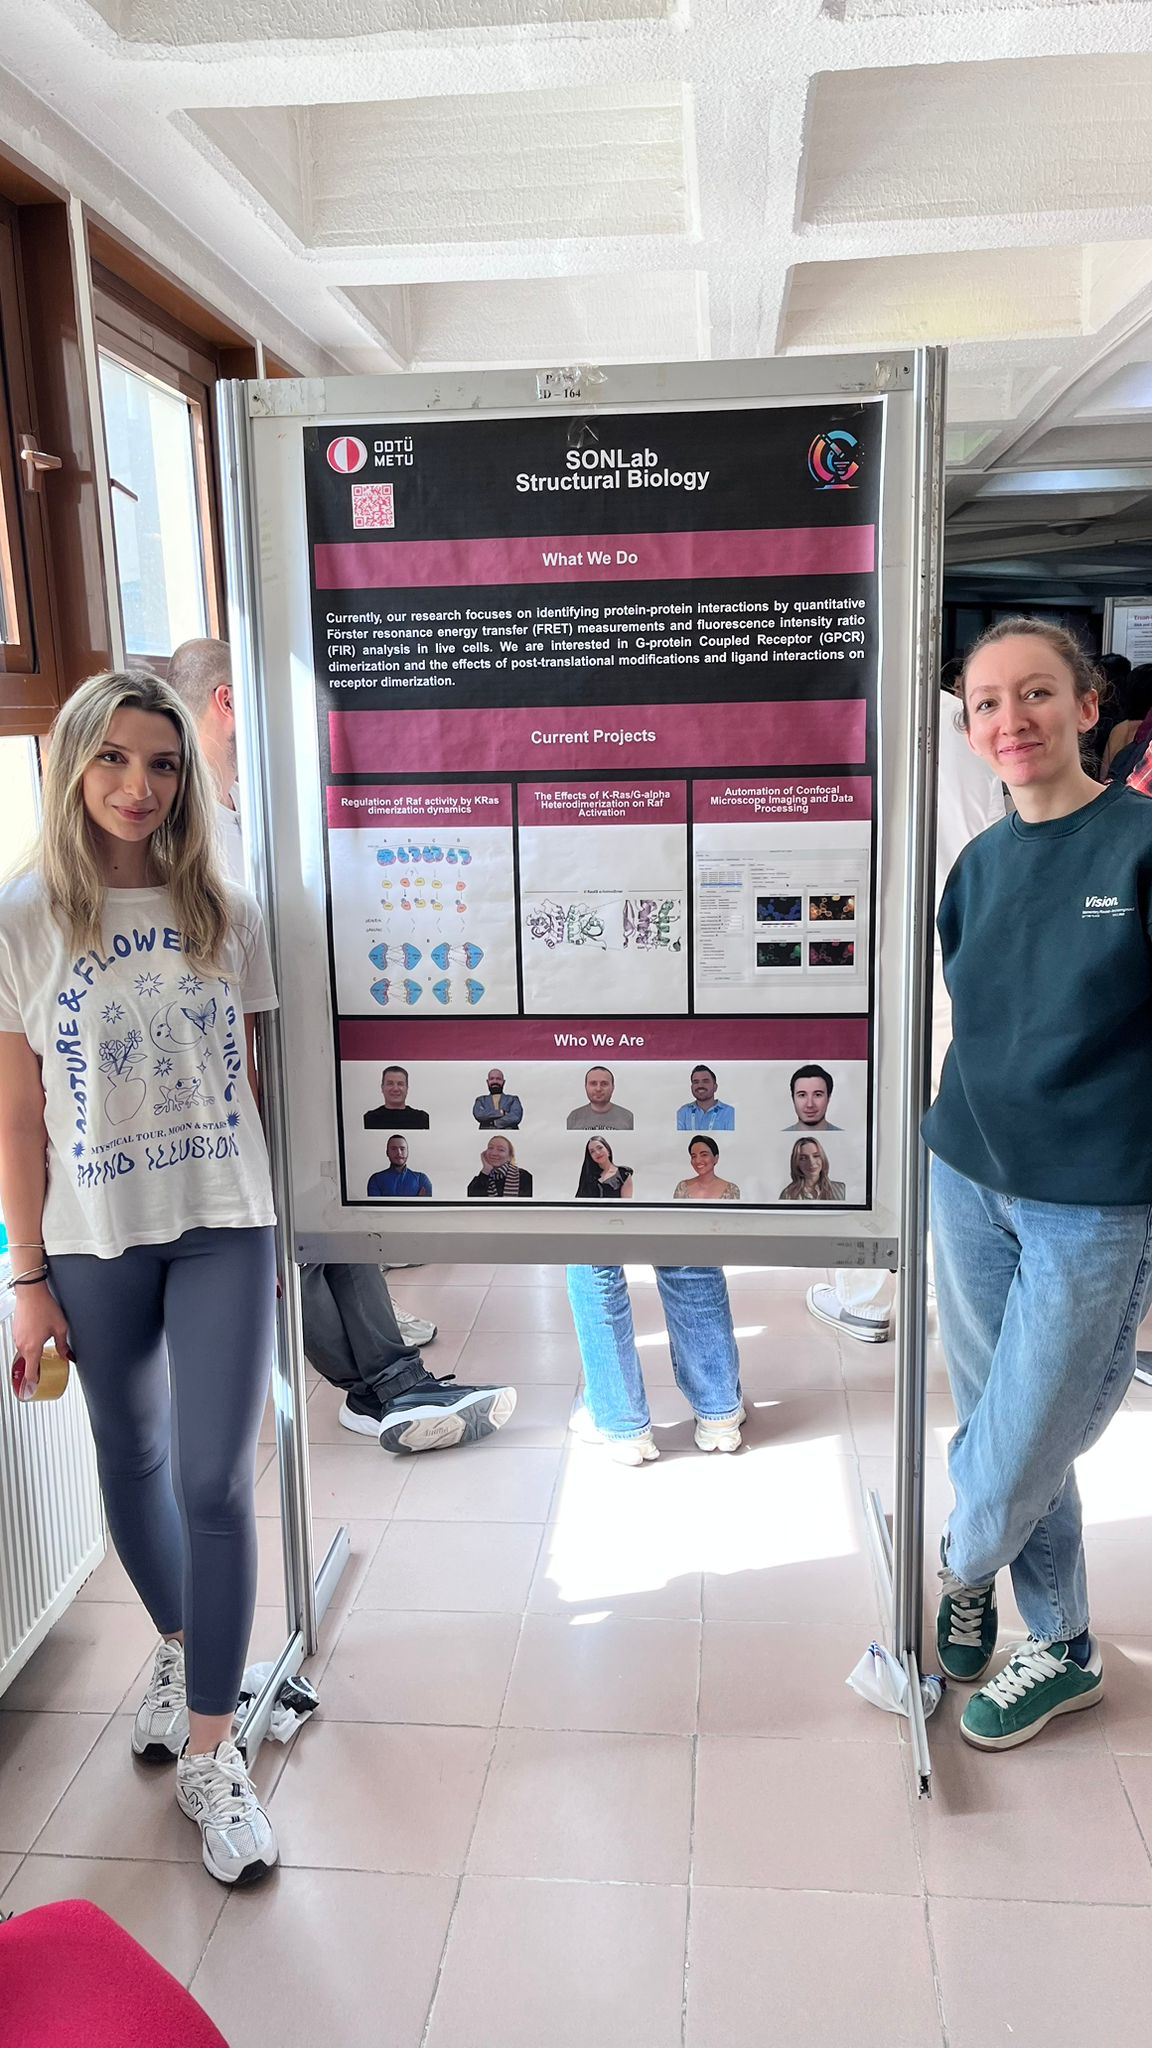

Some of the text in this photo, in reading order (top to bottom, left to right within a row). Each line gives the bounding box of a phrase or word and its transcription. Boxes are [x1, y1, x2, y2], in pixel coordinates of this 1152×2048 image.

[564, 388, 581, 398] 164
[374, 437, 413, 452] ODTÜ
[375, 454, 414, 467] METU
[566, 448, 658, 470] SONLab
[516, 468, 710, 492] Structural Biology
[542, 551, 638, 567] What We Do
[326, 598, 866, 625] Currently, our research focuses on identifying protein-protein interactions by quantitative
[327, 615, 865, 639] Förster resonance energy transfer (FRET) measurements and fluorescence intensity ratio
[327, 630, 865, 658] (FIR) analysis in live cells. We are interested in G-protein Coupled Receptor (GPCR)
[328, 650, 865, 672] dimerization and the effects of post-translational modifications and ligand interactions on
[329, 676, 455, 690] receptor dimerization.
[531, 729, 656, 745] Current Projects
[534, 790, 670, 801] The Effects of K-Ras/G-alpha
[724, 786, 840, 797] Automation of Confocal
[341, 796, 500, 808] Regulation of Raf activity by KRas
[541, 800, 630, 809] Heterodimerization
[647, 798, 664, 807] Raf
[711, 794, 854, 806] Microscope Imaging and Data
[368, 805, 472, 816] dimerization dynamics
[578, 808, 626, 817] Activation
[754, 804, 809, 814] Processing
[554, 1034, 644, 1046] Who We Are
[91, 1135, 134, 1155] MYSTICAL
[136, 1130, 167, 1141] TOUR,
[168, 1122, 192, 1135] MOON
